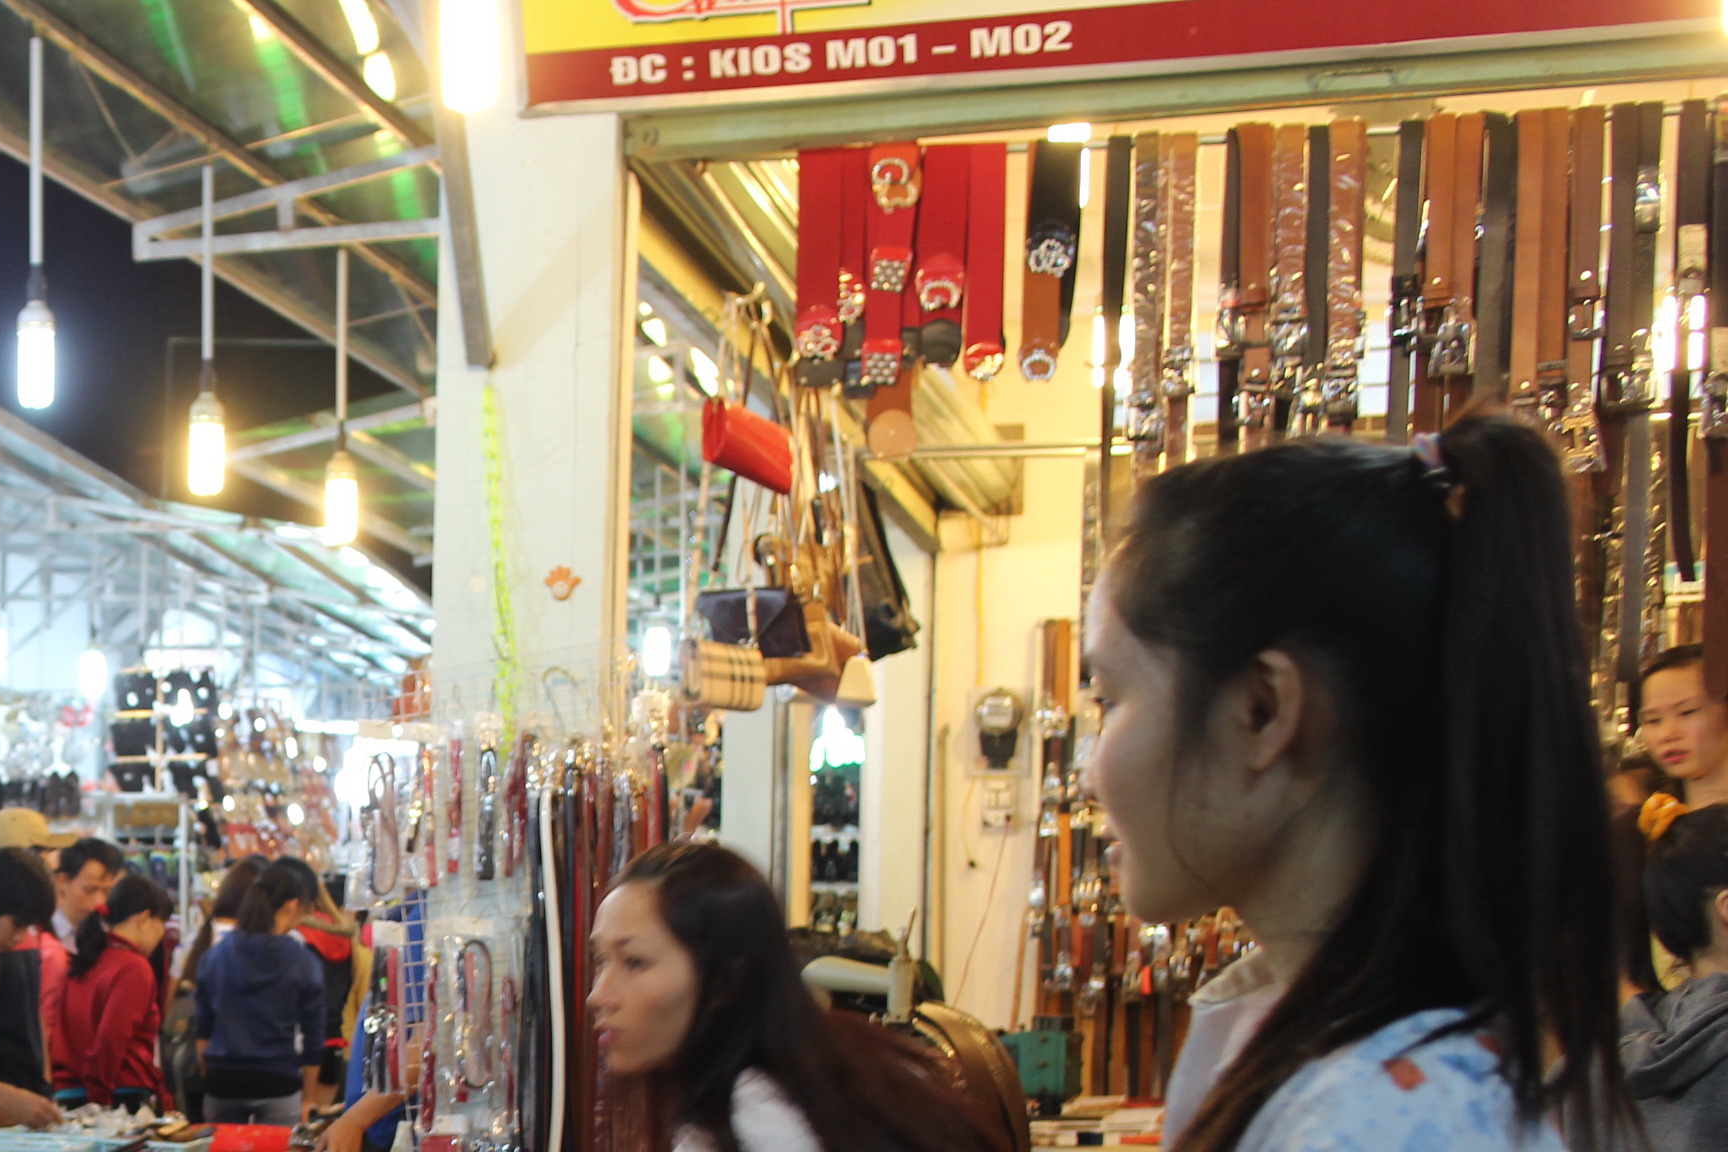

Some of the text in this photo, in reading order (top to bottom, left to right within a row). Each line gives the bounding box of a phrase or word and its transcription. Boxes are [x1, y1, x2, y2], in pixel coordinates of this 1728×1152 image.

[610, 54, 667, 85] ĐC
[708, 42, 812, 79] KIOS
[826, 34, 918, 70] M01
[971, 20, 1073, 58] M02
